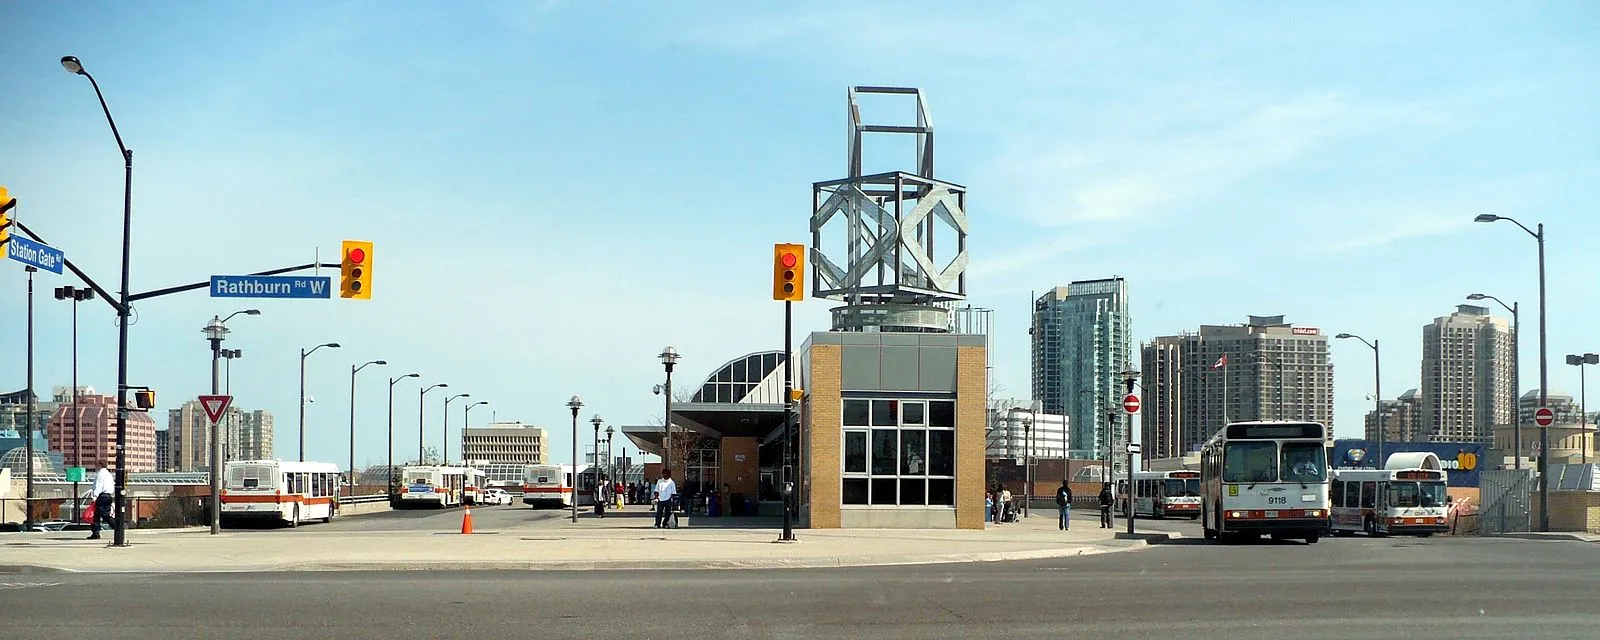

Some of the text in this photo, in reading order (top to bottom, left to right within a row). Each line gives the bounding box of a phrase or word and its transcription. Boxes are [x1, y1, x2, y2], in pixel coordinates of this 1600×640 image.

[11, 239, 62, 269] Station Gate Rd
[217, 279, 325, 294] Rathburn Rd W
[1268, 496, 1287, 504] 9118
